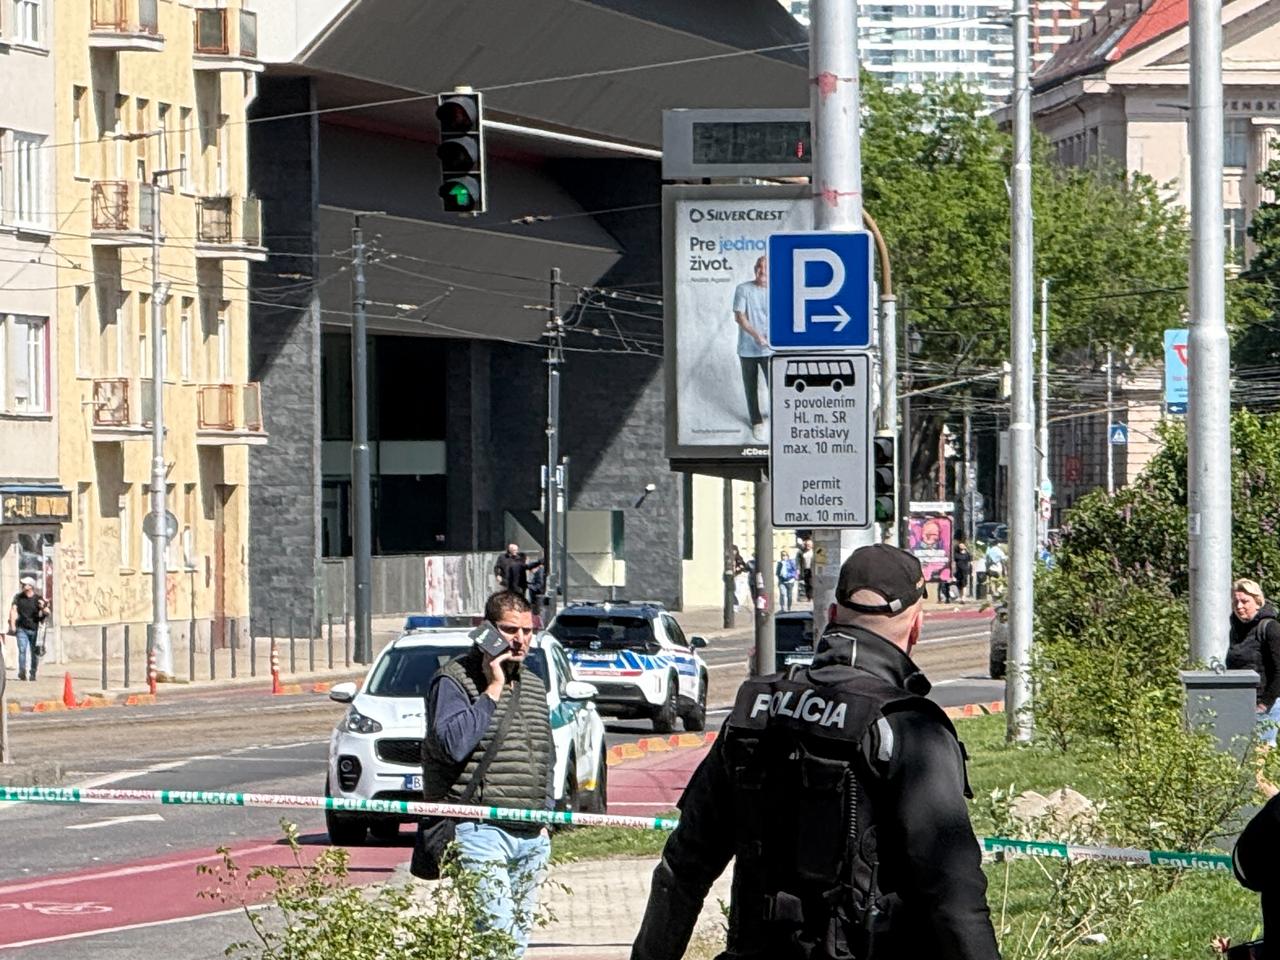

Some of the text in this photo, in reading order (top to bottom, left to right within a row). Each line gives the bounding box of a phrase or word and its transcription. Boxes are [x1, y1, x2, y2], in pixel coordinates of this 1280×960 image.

[690, 235, 767, 255] Pre jedno
[690, 255, 734, 271] život.
[792, 248, 846, 334] P
[784, 395, 856, 411] s povolením
[814, 413, 829, 424] m.
[832, 411, 847, 424] SR
[790, 426, 850, 441] Bratislavy
[741, 447, 770, 456] JCDec
[783, 441, 858, 454] max. 10 min.
[802, 476, 841, 492] permit
[799, 493, 844, 506] holders
[785, 509, 858, 522] max. 10 min.
[750, 688, 848, 729] POLÍCIA
[1157, 856, 1229, 871] POLÍCIA
